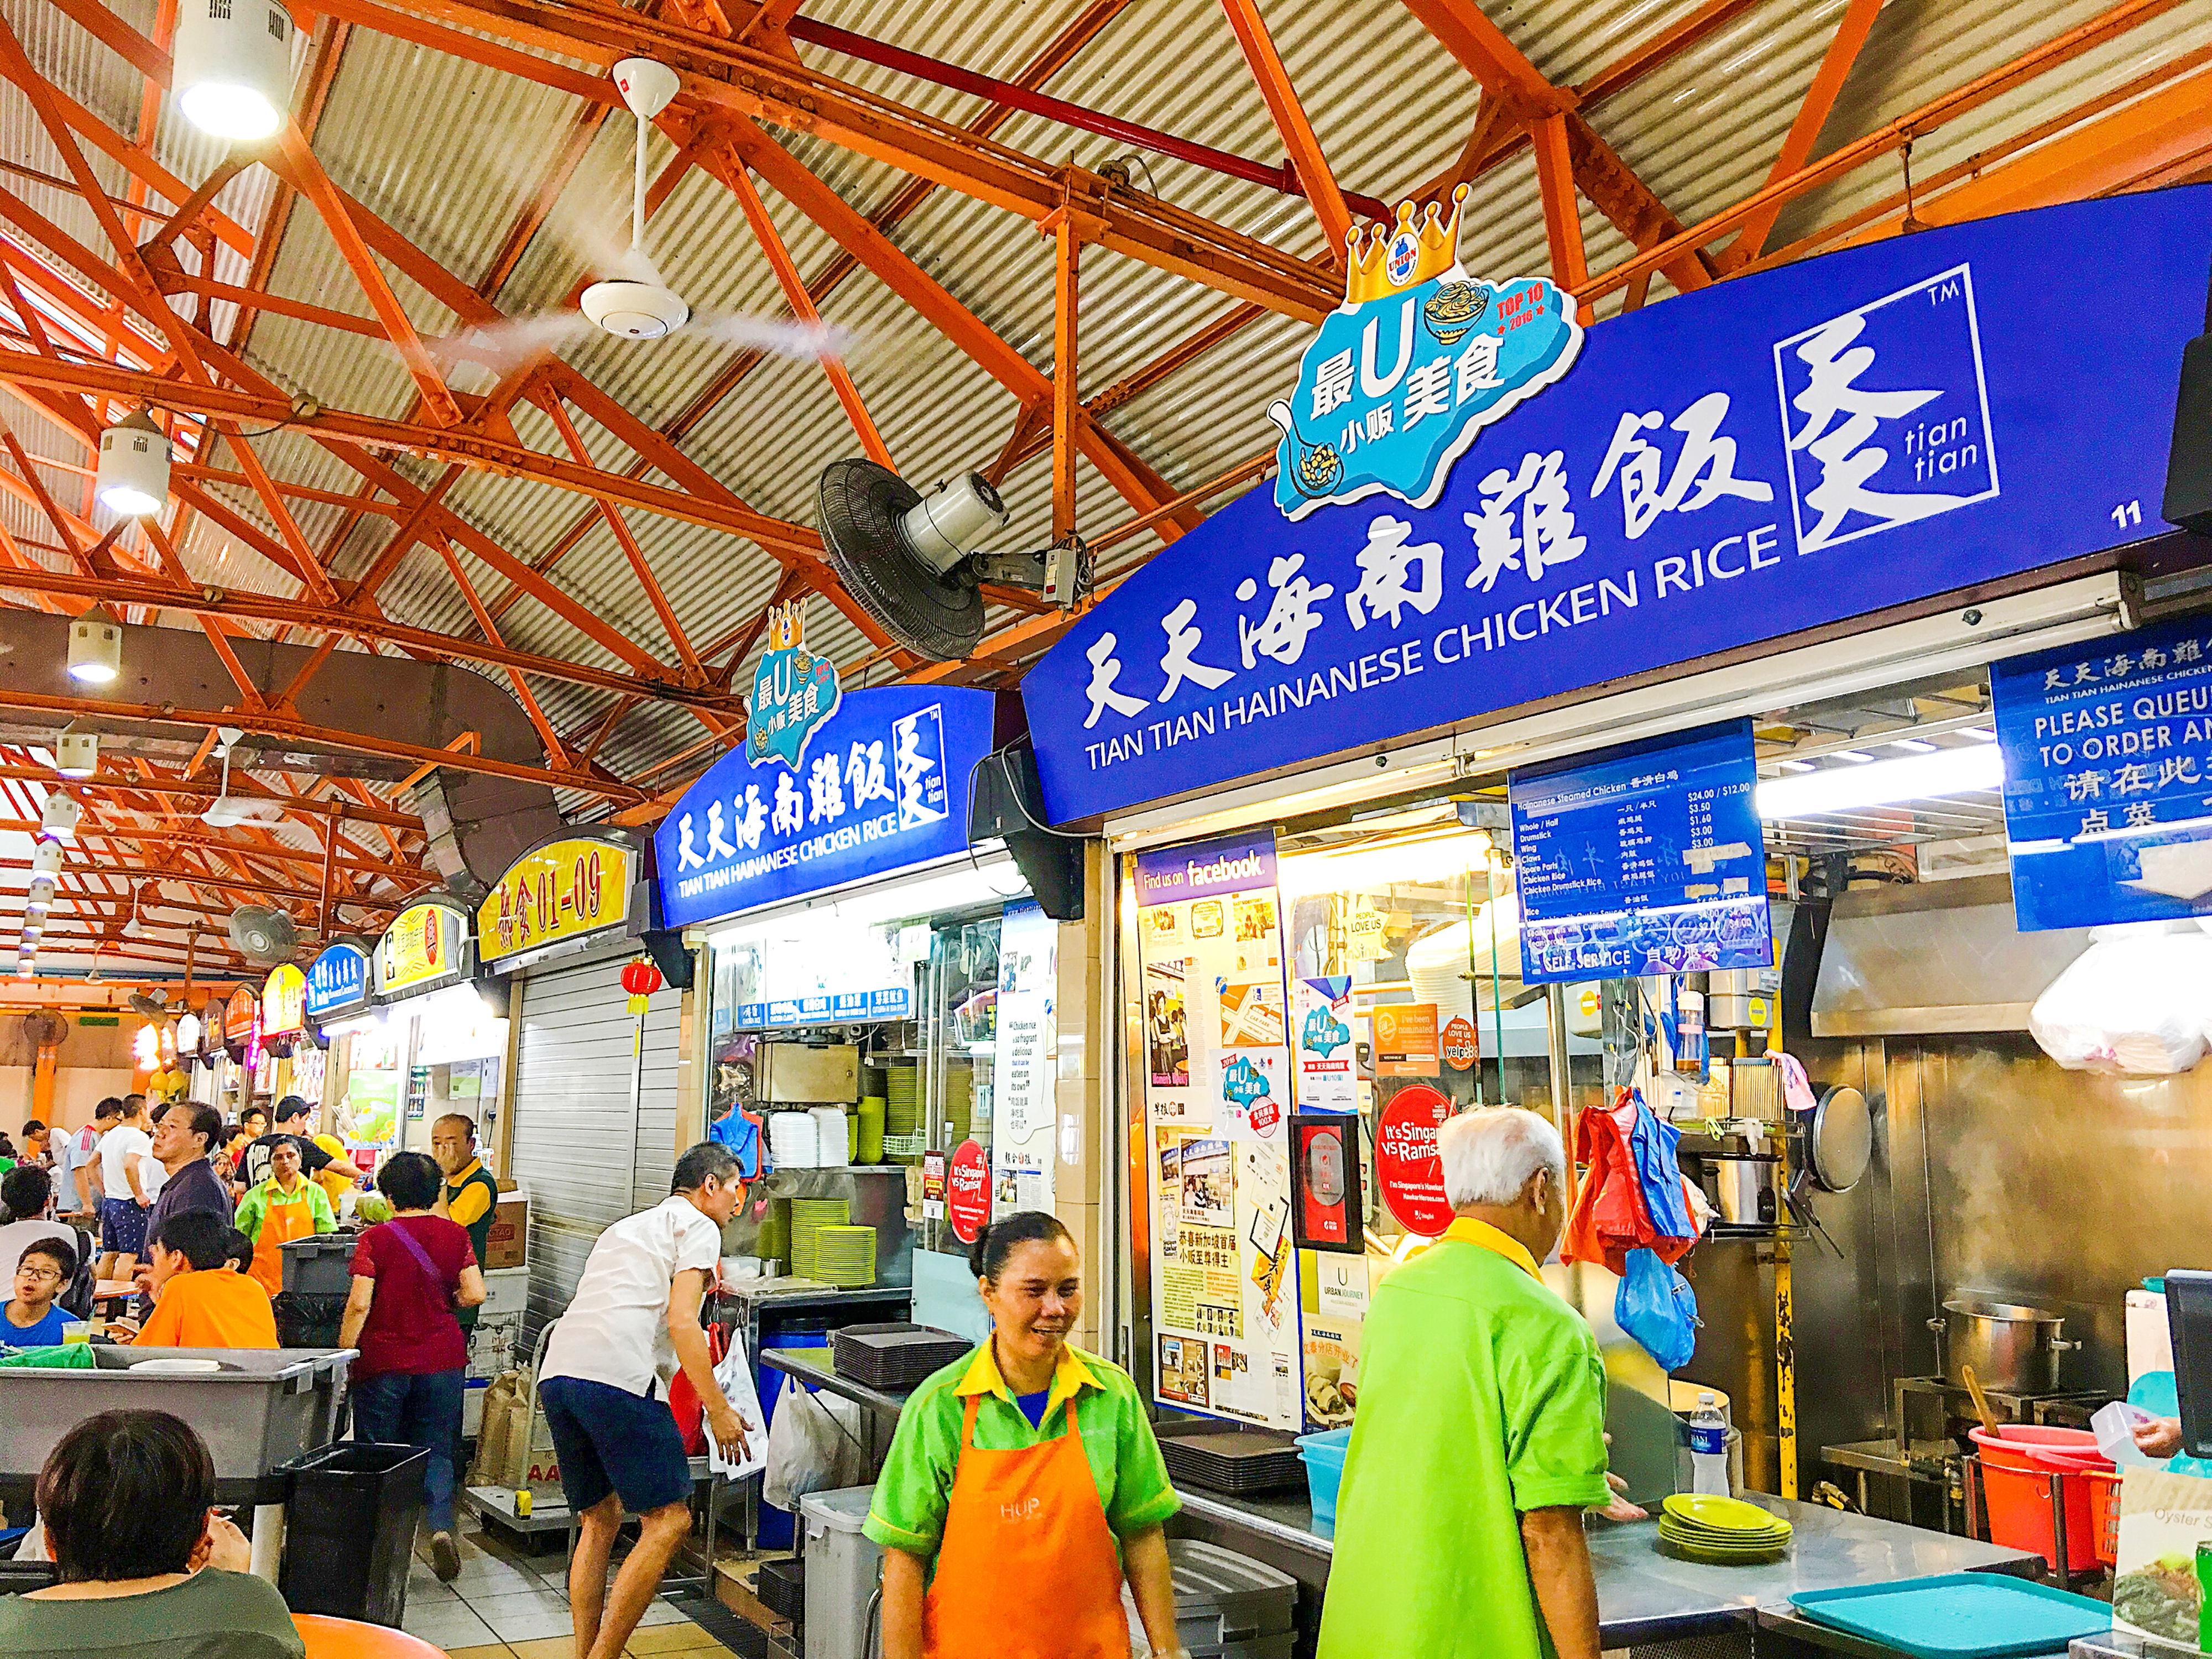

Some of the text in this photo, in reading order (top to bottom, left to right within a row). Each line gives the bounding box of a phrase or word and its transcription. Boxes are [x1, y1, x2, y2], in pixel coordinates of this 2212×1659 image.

[1389, 247, 1416, 272] UNION
[1496, 282, 1543, 320] TOP 10
[1927, 280, 1959, 306] TM
[1509, 310, 1533, 331] 2016
[1905, 416, 1968, 457] tian
[1914, 442, 1978, 483] tian
[2110, 500, 2142, 530] 11
[1084, 523, 1781, 771] TIAN TIAN HAINANESE CHICKEN RICE
[2043, 638, 2212, 691] 天天海南雞
[2046, 694, 2069, 705] TIAN
[2072, 688, 2098, 699] TIAN
[2100, 675, 2164, 695] HAINANESE
[930, 711, 938, 721] TM
[2034, 685, 2212, 739] PLEASE QUEU
[2039, 717, 2212, 768] TO ORDER AN
[925, 774, 941, 791] tian
[927, 789, 944, 805] tian
[1517, 797, 1556, 811] Hainanese
[1557, 789, 1591, 802] Steamed
[1593, 782, 1626, 796] Chicken
[1688, 790, 1714, 802] $24.00
[1723, 782, 1750, 796] $12.00
[1689, 802, 1710, 814] $3.50
[1519, 822, 1539, 832] Whole
[1690, 813, 1712, 826] $1.60
[1520, 831, 1552, 843] Drumstick
[1691, 826, 1713, 837] $3.00
[1521, 844, 1537, 854] Wing
[1692, 837, 1714, 849] $3.00
[678, 812, 897, 899] TIAN TIAN HAINANESE CHICKEN RICE
[1521, 855, 1541, 864] Claws
[1522, 861, 1558, 875] Spare Parts
[1144, 872, 1161, 890] Find
[1162, 875, 1172, 886] us
[1173, 872, 1184, 885] on
[1523, 872, 1566, 884] Chicken Rice
[1524, 877, 1602, 895] Chicken Drumstick Rice
[537, 849, 601, 932] 01-09
[1351, 919, 1381, 932] LOVE US
[1544, 949, 1631, 971] SELF-SERVICE
[1414, 1014, 1430, 1023] been
[1398, 1024, 1434, 1034] nominated!
[1020, 1034, 1037, 1045] fragrant
[1223, 1054, 1235, 1067] 2016
[1446, 1044, 1465, 1060] yelp
[1385, 1121, 1439, 1144] It's Singa
[1398, 1142, 1440, 1162] Ramsa
[1398, 1181, 1425, 1191] Singapore's
[1425, 1183, 1444, 1191] Hawker
[1001, 1496, 1041, 1518] HUP
[2154, 1507, 2200, 1526] Oyster
